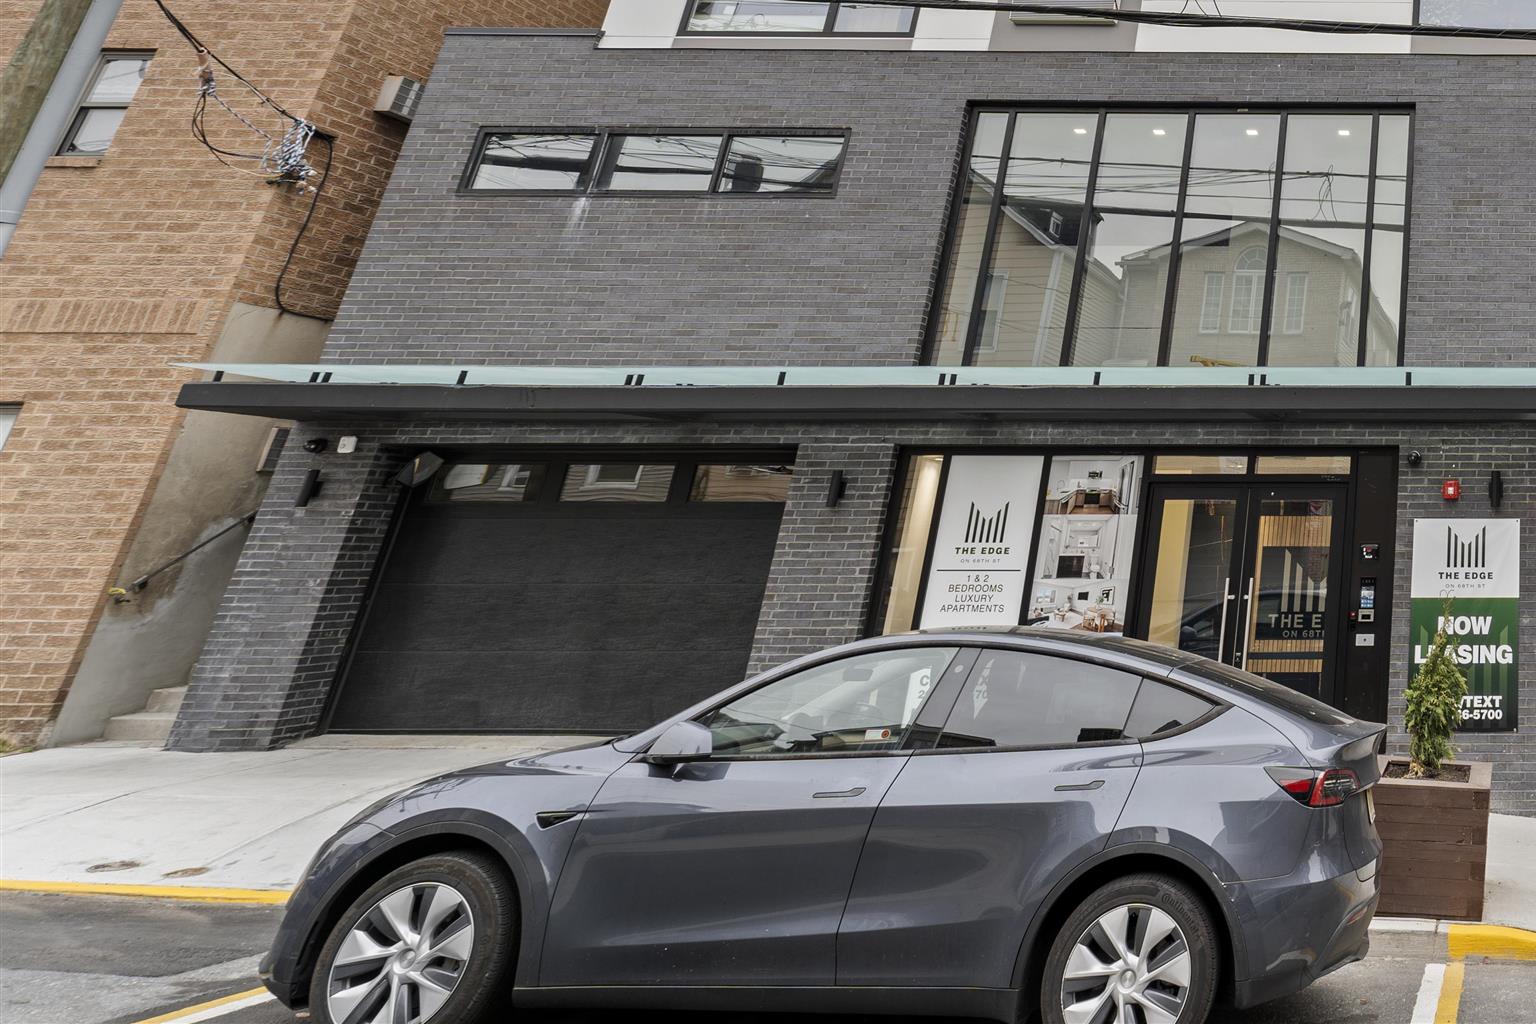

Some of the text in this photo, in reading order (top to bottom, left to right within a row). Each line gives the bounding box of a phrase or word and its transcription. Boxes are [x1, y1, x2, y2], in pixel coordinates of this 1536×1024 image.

[955, 547, 1010, 555] THE EDGE
[1438, 571, 1494, 580] THE EDGE
[948, 584, 1004, 593] BEDROOMS
[954, 594, 994, 603] LUXURY
[939, 604, 1005, 613] APARTMENTS
[1268, 613, 1304, 628] THE
[1437, 615, 1493, 636] NOW
[1282, 629, 1298, 638] ON
